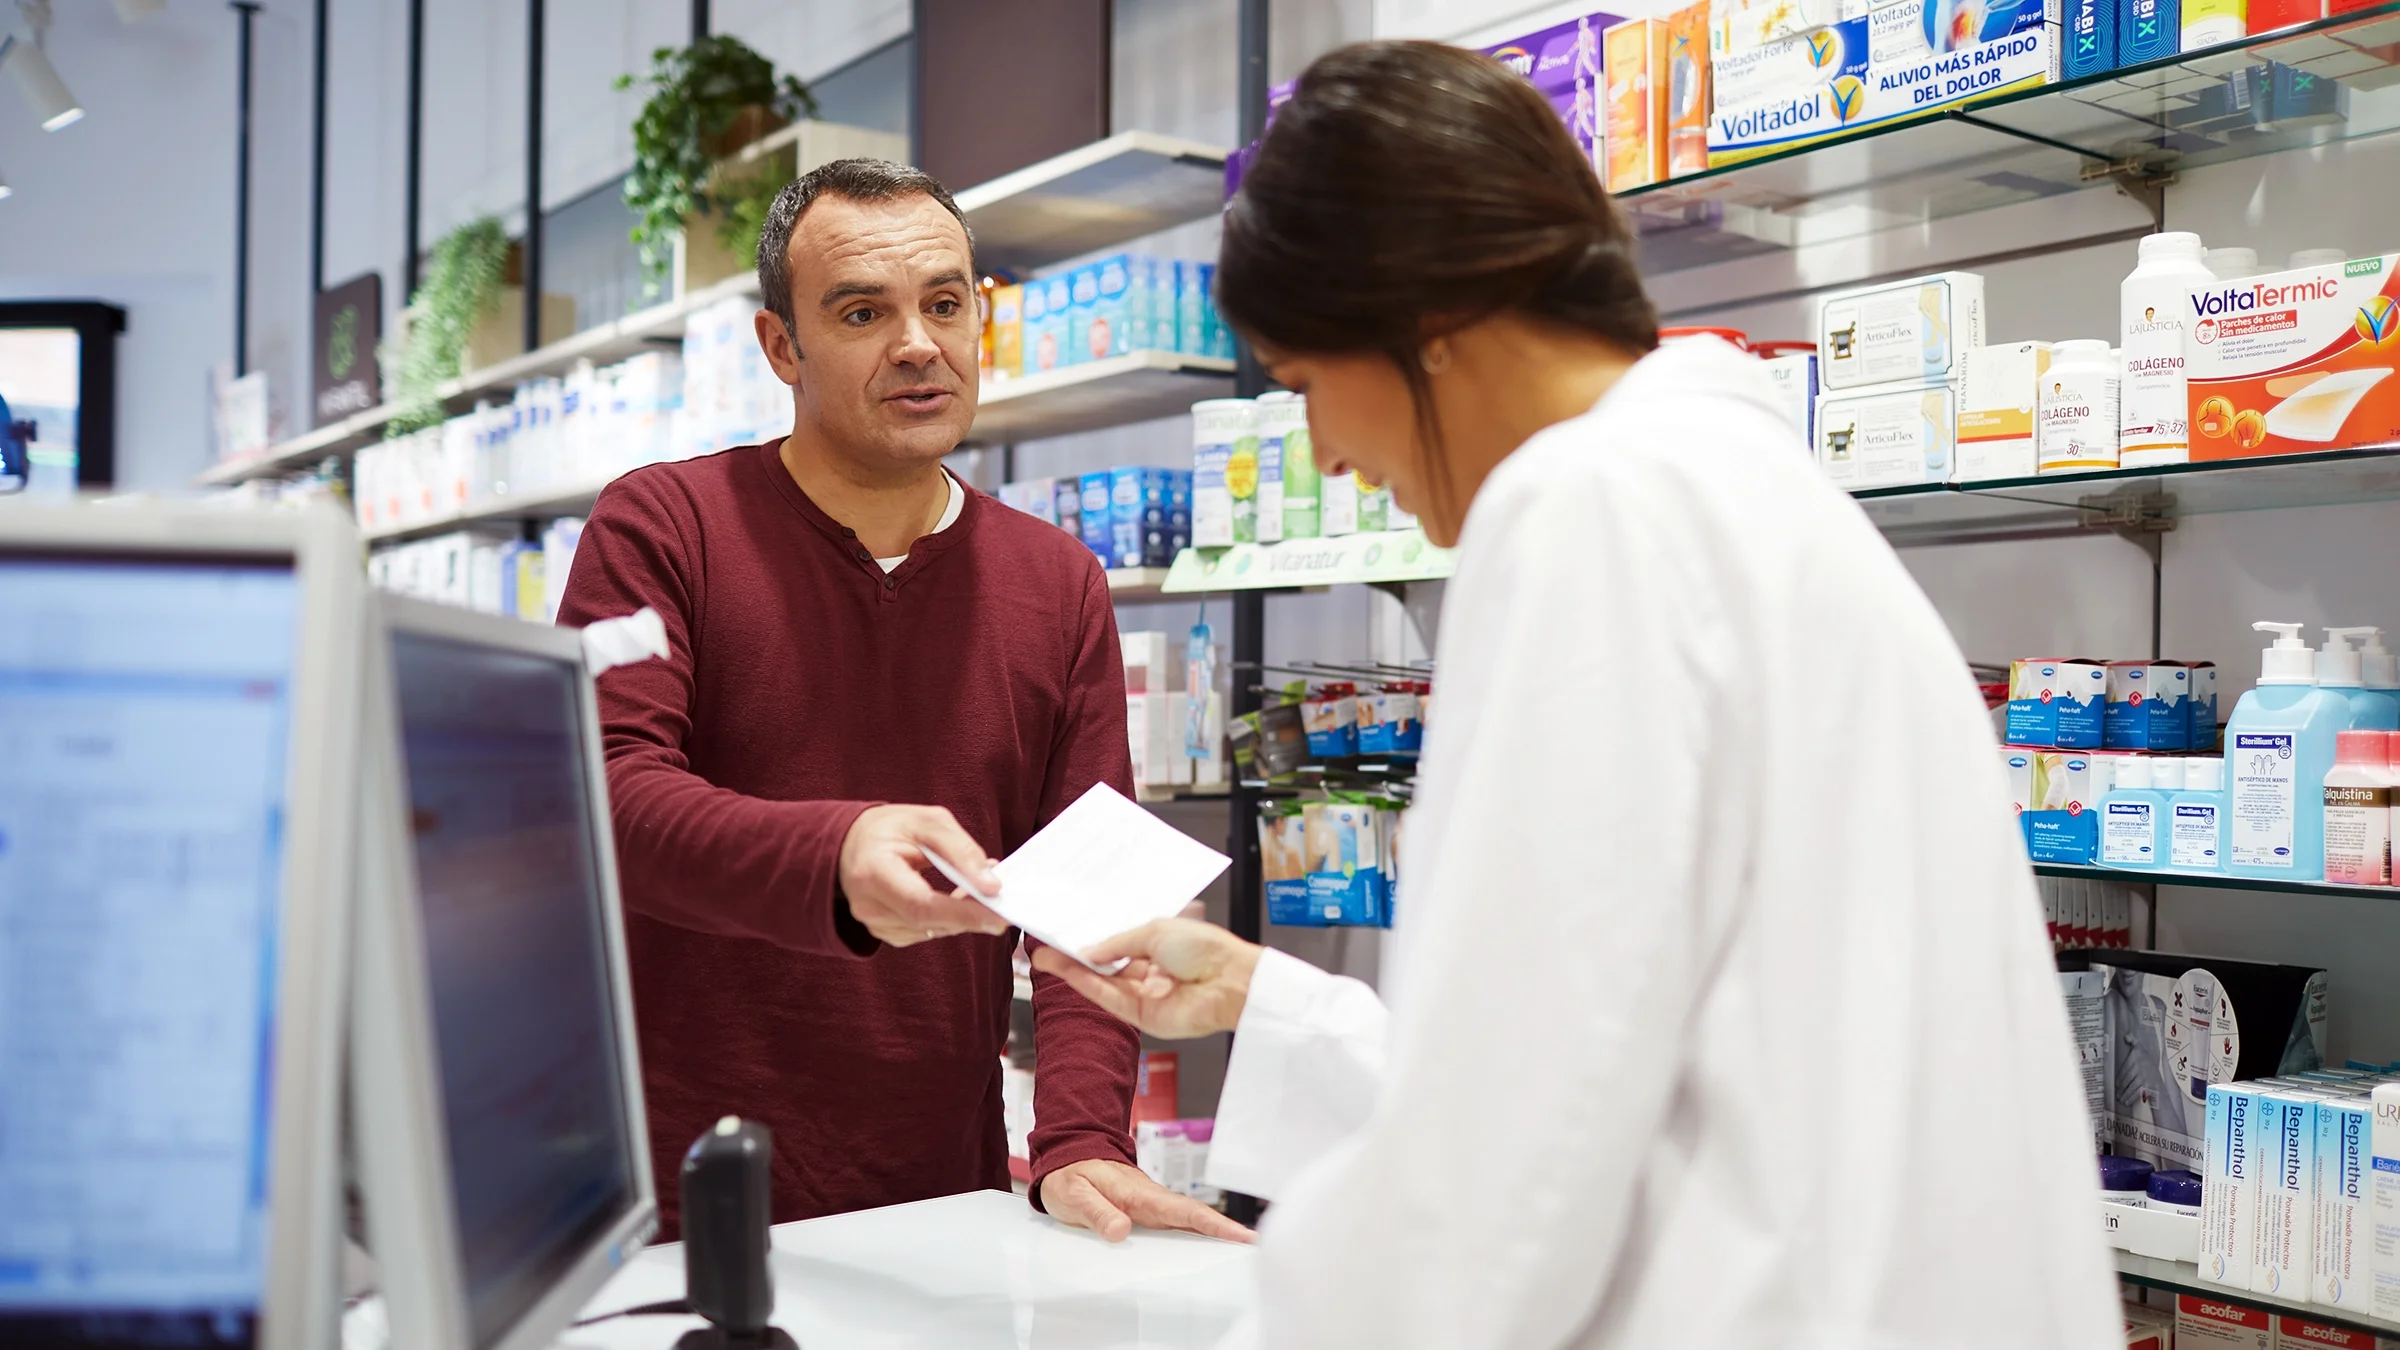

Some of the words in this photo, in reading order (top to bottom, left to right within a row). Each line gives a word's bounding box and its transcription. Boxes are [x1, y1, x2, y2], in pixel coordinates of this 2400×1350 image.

[2018, 14, 2027, 22] 50
[2032, 10, 2043, 20] gel
[1879, 65, 1931, 91] ALIVIO
[1936, 52, 1970, 77] MÁS
[1975, 36, 2038, 64] RÁPIDO
[1914, 85, 1943, 104] DEL
[1947, 68, 2001, 95] DOLOR
[1721, 93, 1820, 141] Voltadol
[2346, 261, 2380, 274] NUEVO
[2191, 276, 2338, 317] VoltaTermic
[2129, 321, 2184, 335] LAJUSTICIA
[2221, 317, 2252, 328] Parches
[2253, 315, 2264, 324] de
[2265, 312, 2286, 322] calor
[2221, 328, 2233, 337] Sin
[2235, 320, 2295, 335] medicamentos
[1864, 327, 1913, 343] ArticuFlex
[2128, 356, 2185, 373] COLÁGENO
[2142, 370, 2174, 378] MAGNESIO
[2041, 406, 2090, 422] COLÁGENO
[2051, 418, 2080, 426] MAGNESIO
[2155, 423, 2165, 434] 75
[1864, 430, 1914, 445] ArticuFlex
[2066, 443, 2079, 456] 30
[2010, 704, 2032, 712] Peha-haft
[2058, 706, 2081, 714] Peha-haft
[2240, 736, 2273, 745] Sterillium
[2274, 737, 2287, 746] Gel
[2034, 821, 2060, 830] Peha-haft
[2193, 984, 2209, 995] Eucerin
[2311, 980, 2328, 995] Eucerin
[2139, 1131, 2161, 1147] ACELERA
[2161, 1138, 2169, 1149] SU
[2169, 1141, 2204, 1162] REPARACIÓN
[2232, 1096, 2248, 1180] Bepanthol
[2286, 1105, 2304, 1191] Bepanthol
[2345, 1113, 2363, 1199] Bepanthol
[2229, 1185, 2238, 1216] Pomada
[2284, 1196, 2293, 1227] Pomada
[2345, 1205, 2354, 1237] Pomada
[2227, 1217, 2236, 1257] Protectora
[2282, 1229, 2291, 1270] Protectora
[2343, 1238, 2353, 1280] Protectora
[2200, 1303, 2246, 1321] acofar
[2302, 1325, 2351, 1344] acofar
